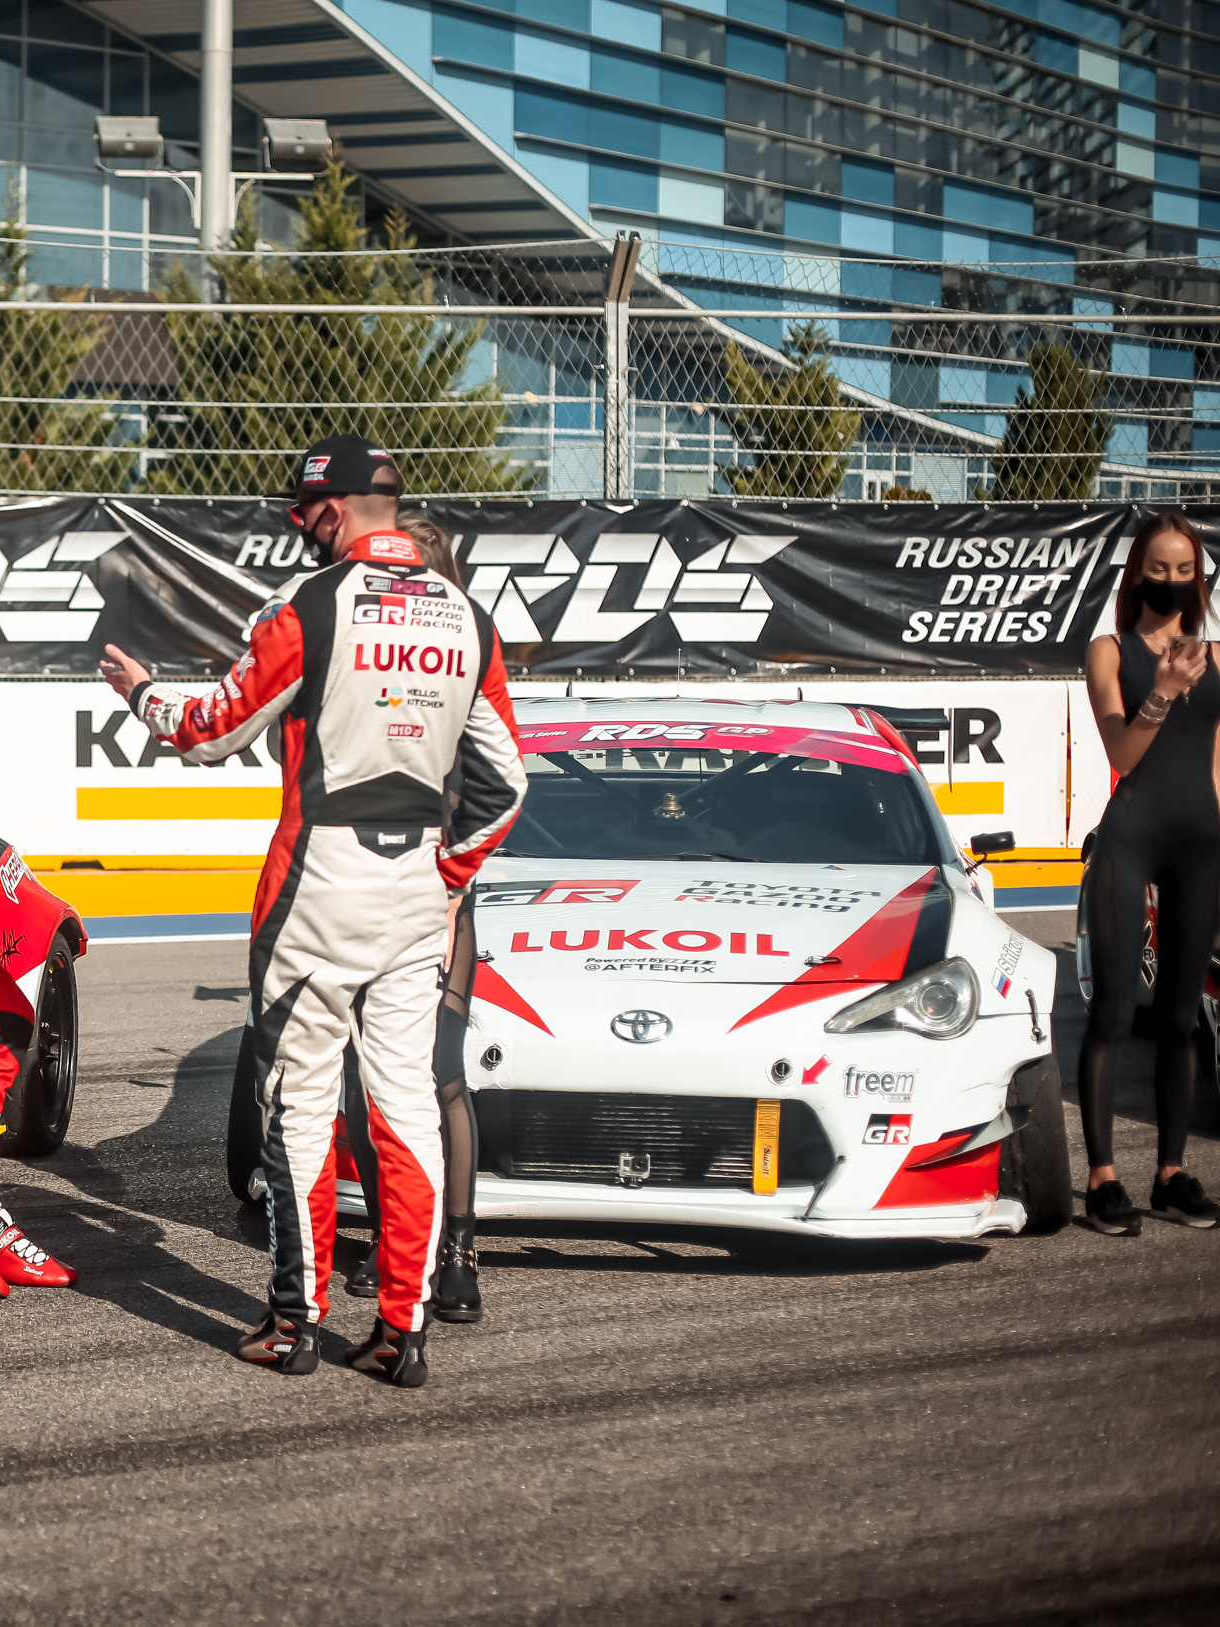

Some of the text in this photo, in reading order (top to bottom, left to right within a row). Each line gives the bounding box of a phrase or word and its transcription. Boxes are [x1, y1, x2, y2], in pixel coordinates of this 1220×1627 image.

[895, 536, 1086, 568] RUSSIAN
[466, 533, 799, 642] RDS
[940, 574, 1071, 605] DRIFT
[354, 603, 406, 625] GR
[411, 598, 465, 612] TOYOTA
[411, 608, 462, 621] GAZOO
[410, 618, 463, 633] Racing
[901, 611, 1052, 643] SERIES
[354, 643, 466, 678] LUKOIL
[534, 730, 570, 738] Series
[579, 723, 770, 742] RDS GP
[478, 884, 631, 906] GR
[682, 888, 862, 904] GAZOO
[690, 880, 881, 897] TOYOTA
[674, 894, 852, 914] Racing
[510, 930, 791, 957] LUKOIL
[584, 963, 716, 974] @AFTERFIX
[844, 1066, 915, 1093] freem
[864, 1126, 911, 1144] GR
